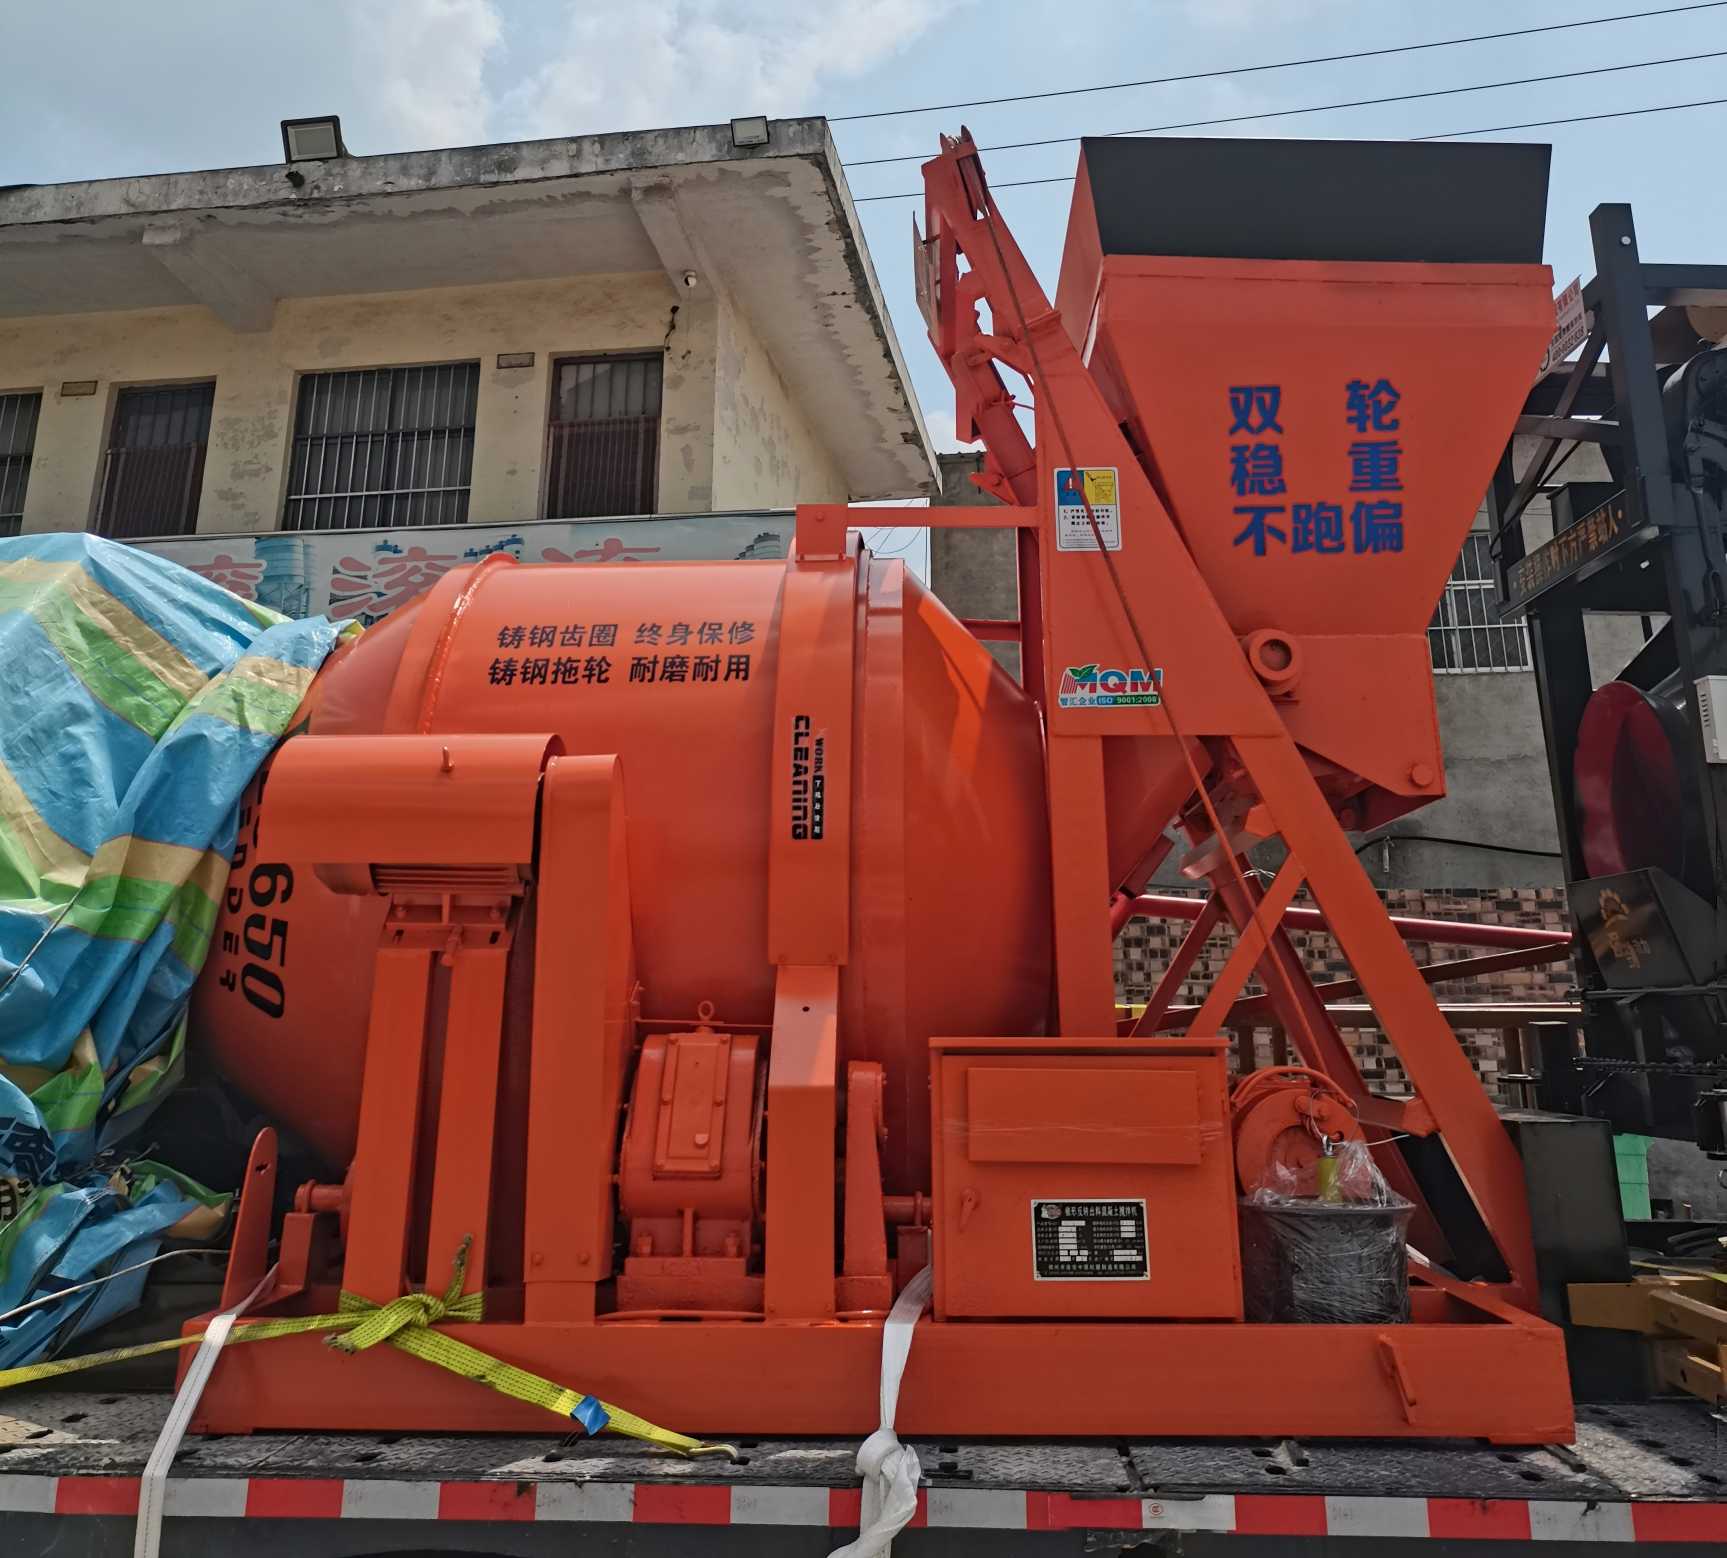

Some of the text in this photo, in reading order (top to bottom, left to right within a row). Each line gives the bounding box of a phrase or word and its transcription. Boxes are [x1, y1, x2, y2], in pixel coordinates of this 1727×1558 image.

[1229, 379, 1401, 436] 双 轮
[1230, 441, 1404, 496] 稳 重
[1233, 500, 1404, 556] 不跑偏
[497, 620, 757, 649] 铸钢齿圈 终身保修
[488, 654, 752, 686] 铸钢拖轮 耐磨耐用
[1098, 696, 1113, 704] ISO
[814, 738, 824, 773] WORK
